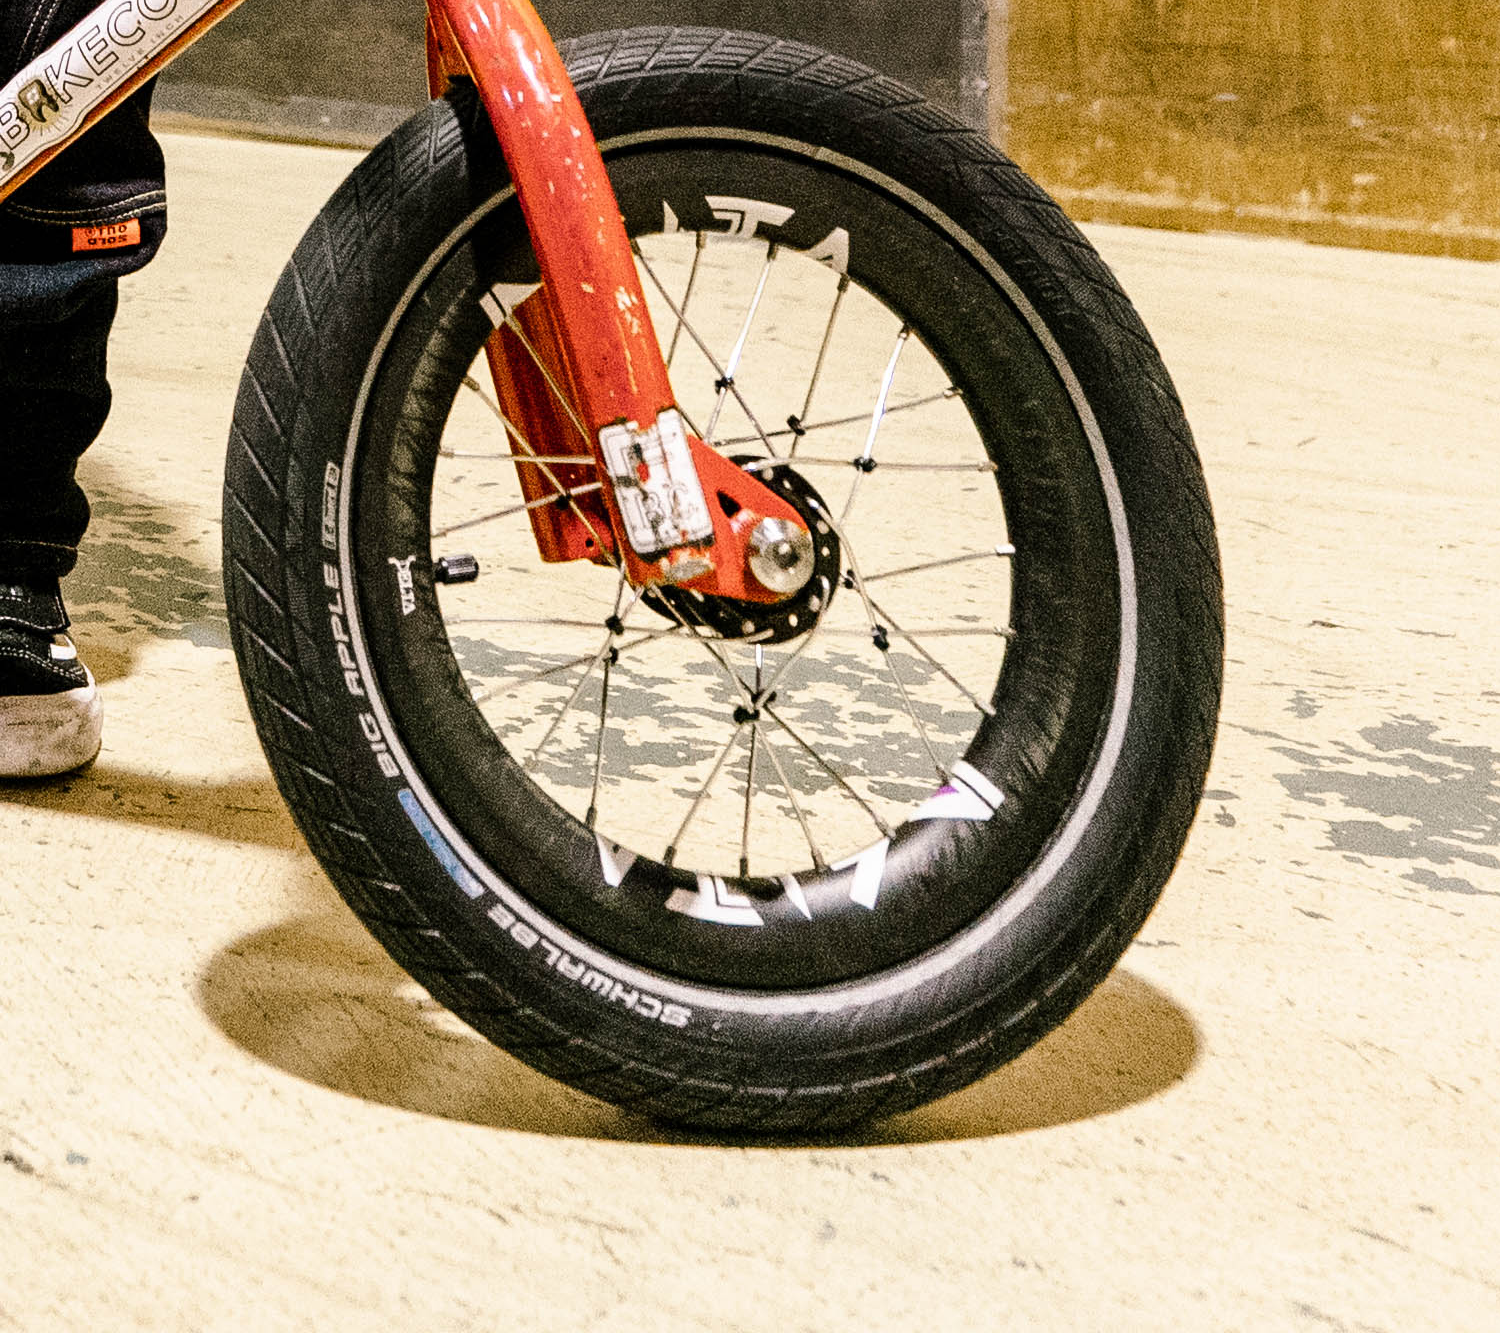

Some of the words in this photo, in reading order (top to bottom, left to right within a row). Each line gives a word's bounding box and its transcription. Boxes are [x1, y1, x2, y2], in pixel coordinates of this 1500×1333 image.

[149, 14, 184, 46] INCH
[323, 562, 365, 697] APPLE
[358, 712, 401, 777] BIG
[487, 904, 692, 1028] SCHWALBE
